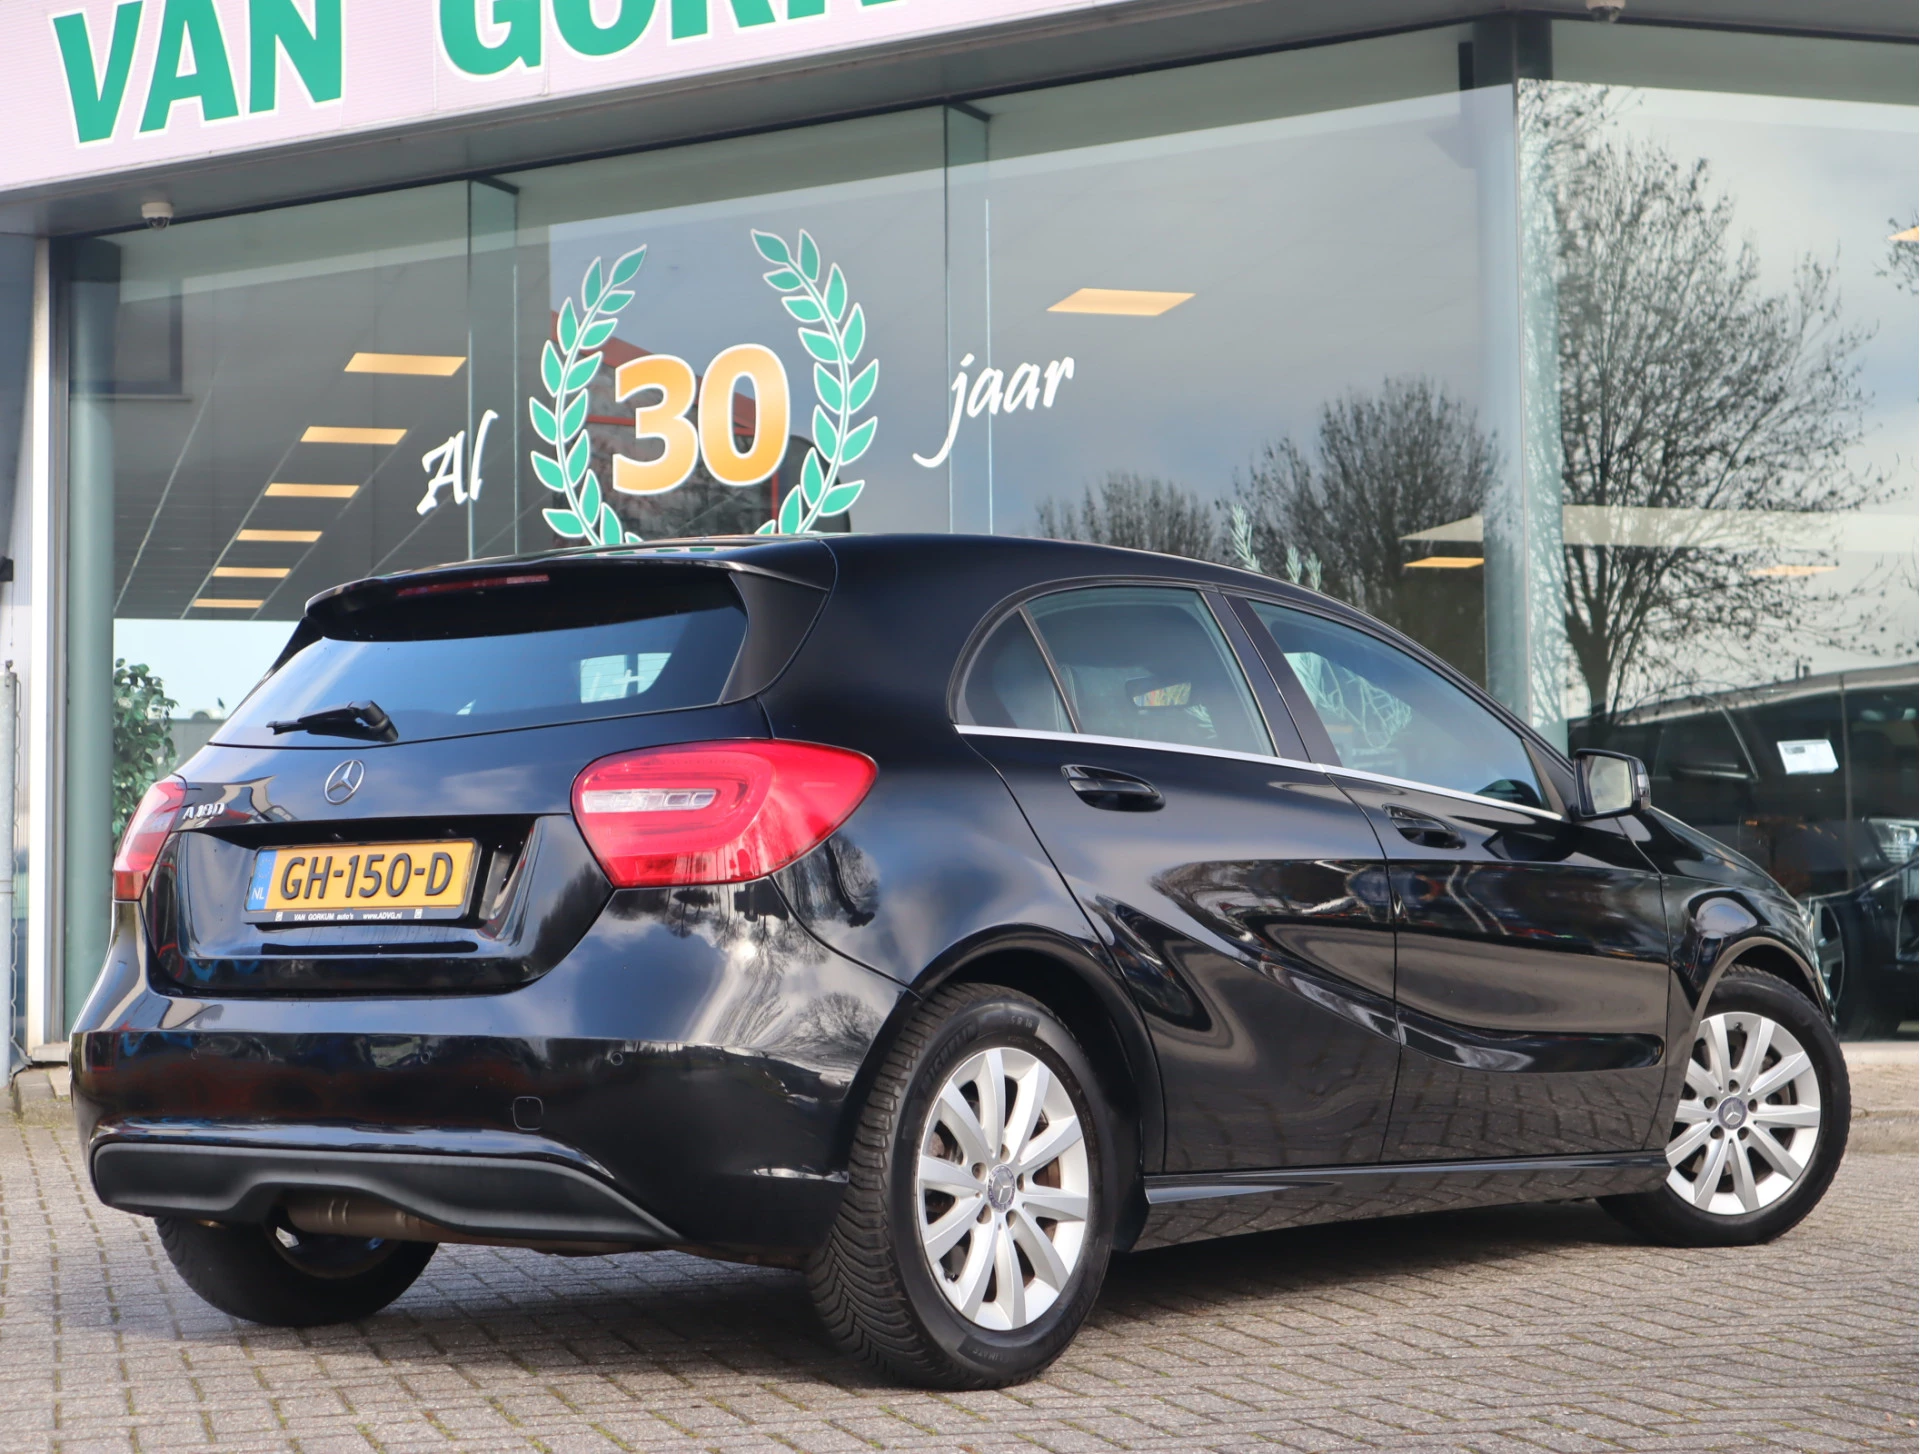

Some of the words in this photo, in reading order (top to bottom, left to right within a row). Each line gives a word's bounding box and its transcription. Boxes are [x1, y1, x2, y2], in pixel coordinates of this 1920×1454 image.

[51, 0, 343, 144] VAN
[416, 409, 498, 514] Al
[611, 343, 791, 495] 30
[912, 352, 1075, 468] jaar
[252, 887, 265, 900] NL
[280, 851, 454, 901] GH-150-D
[294, 913, 306, 921] VAN
[308, 912, 335, 921] GORKUM
